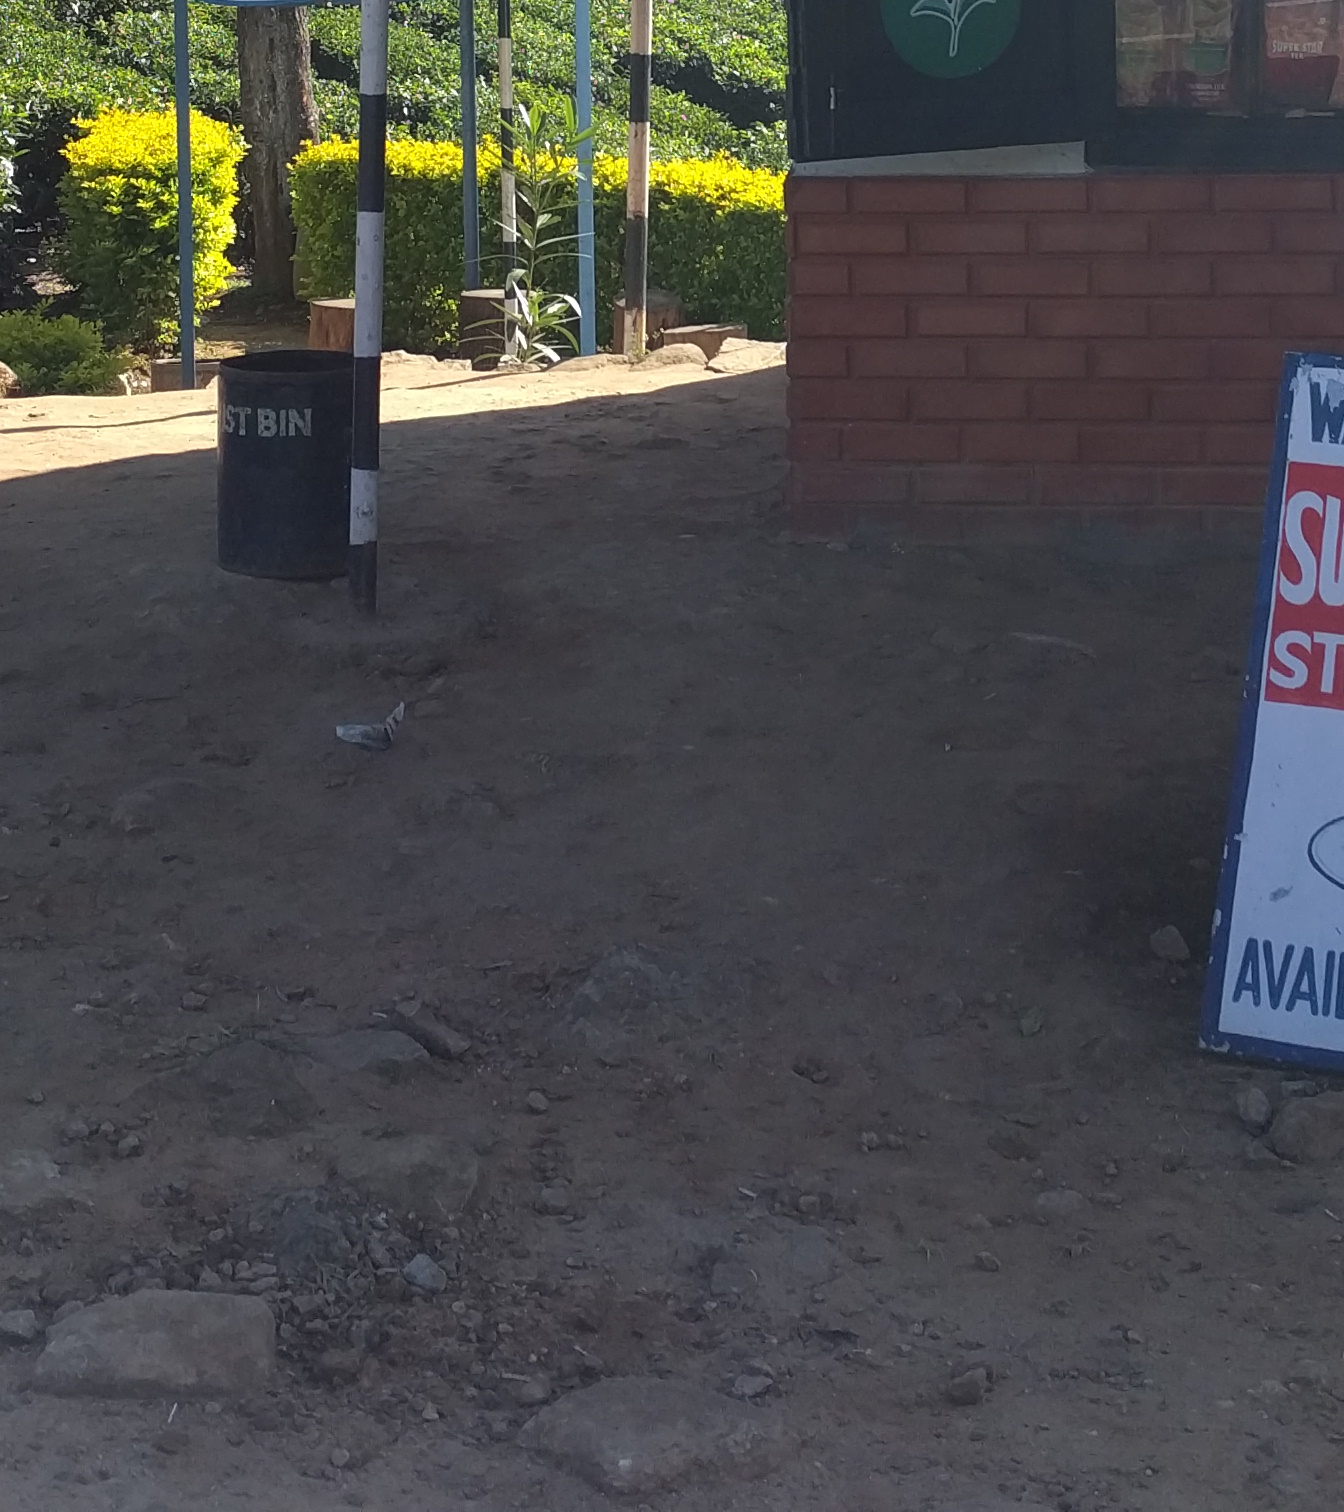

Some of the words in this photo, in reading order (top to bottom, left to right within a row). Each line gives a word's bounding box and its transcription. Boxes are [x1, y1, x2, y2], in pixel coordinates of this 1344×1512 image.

[1272, 40, 1300, 53] SUPER
[1302, 40, 1324, 54] STAR
[257, 408, 312, 437] BIN
